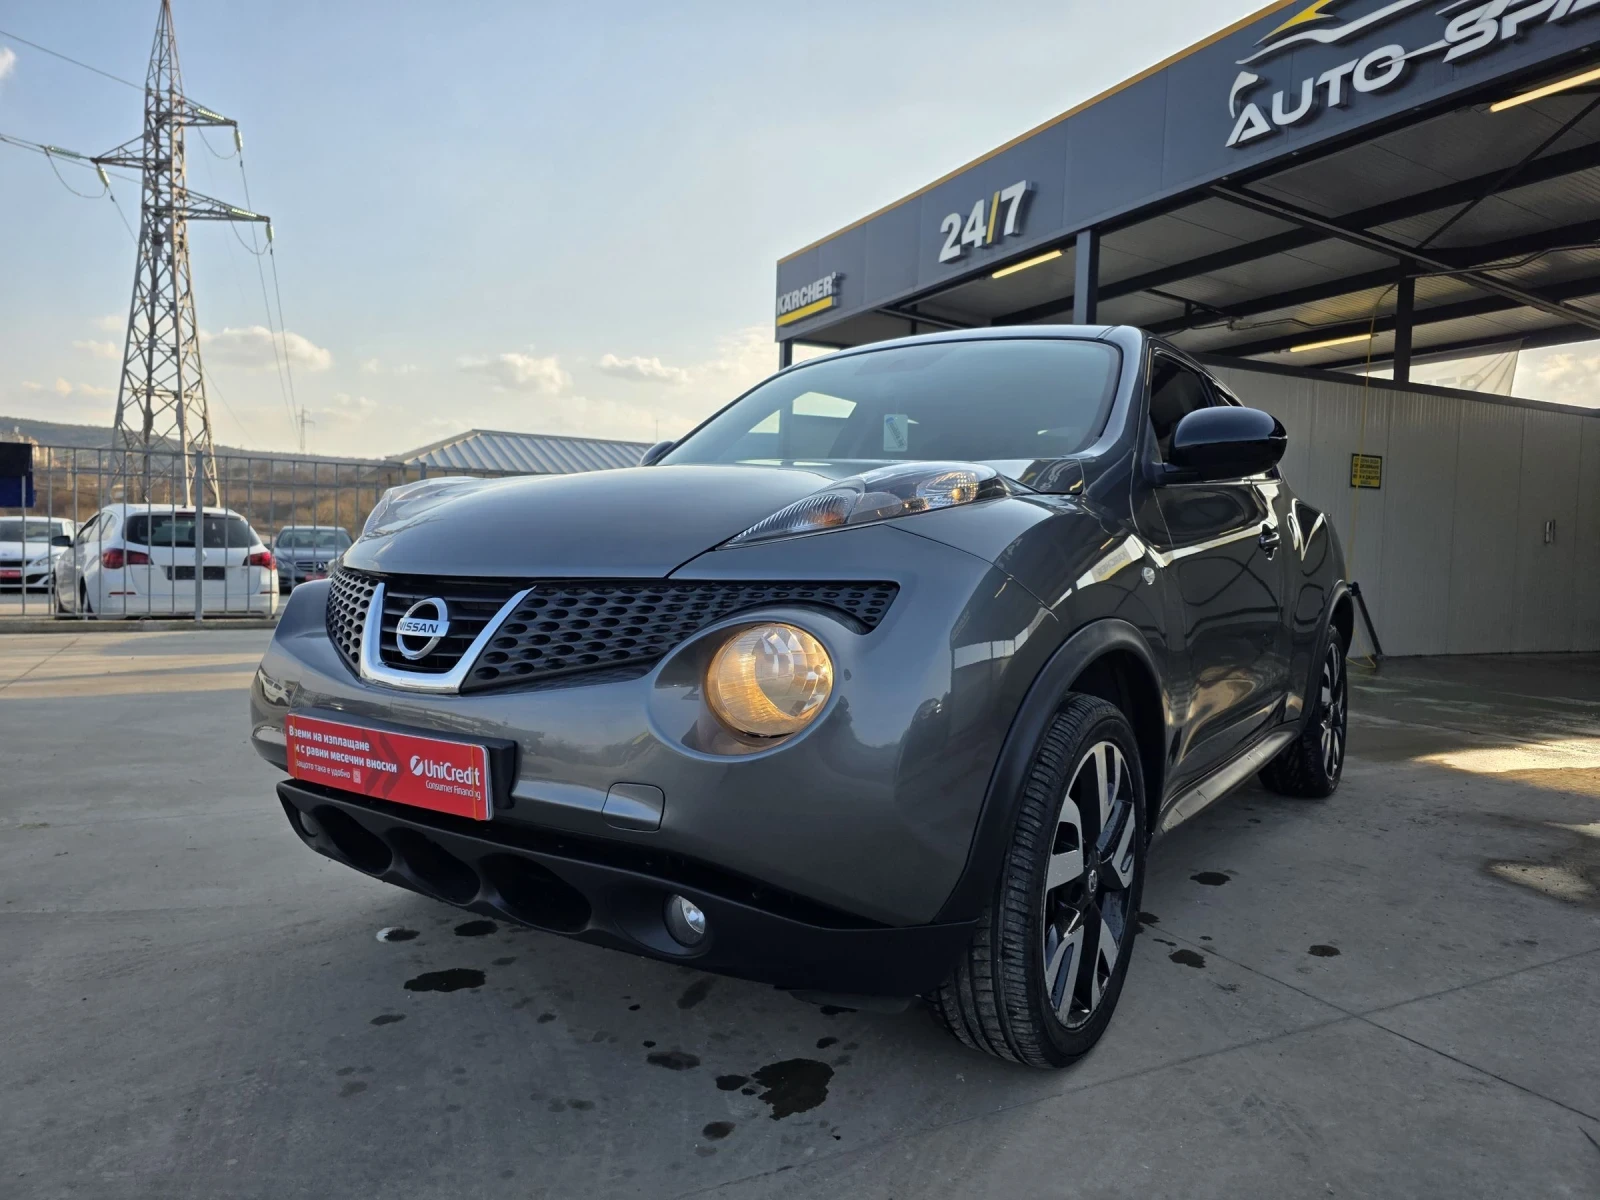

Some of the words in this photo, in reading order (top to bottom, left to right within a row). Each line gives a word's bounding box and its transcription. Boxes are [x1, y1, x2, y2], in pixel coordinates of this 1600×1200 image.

[1225, 44, 1406, 148] AUTO
[938, 179, 1028, 263] 24/7
[398, 621, 439, 634] NISSAN
[313, 732, 323, 743] на
[323, 734, 370, 752] изплащане
[306, 745, 330, 759] равни
[330, 751, 365, 767] месечни
[366, 758, 398, 773] вноски
[424, 758, 481, 787] UniCredit
[426, 780, 453, 794] Consumer
